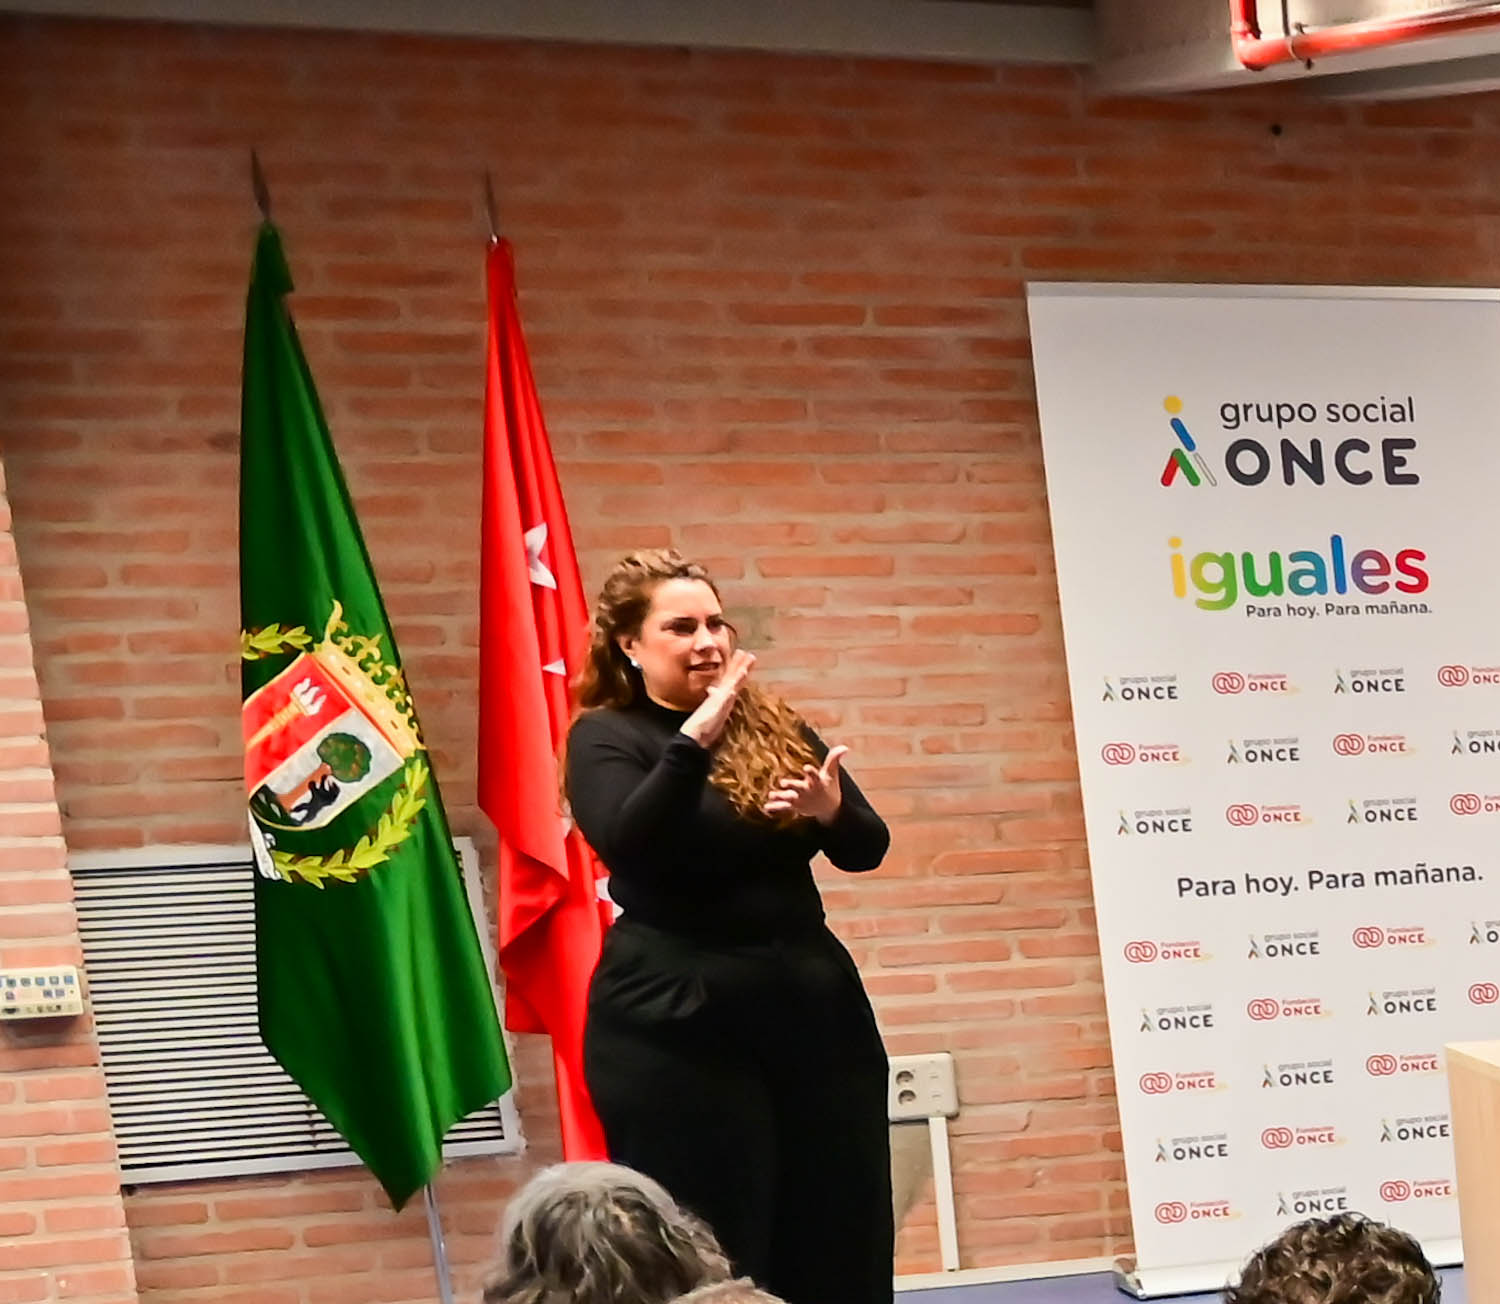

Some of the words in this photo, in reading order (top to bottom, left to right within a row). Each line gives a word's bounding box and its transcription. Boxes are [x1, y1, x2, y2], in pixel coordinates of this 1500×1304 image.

[1221, 403, 1316, 429] grupo
[1327, 396, 1414, 422] social
[1225, 438, 1419, 486] ONCE
[1168, 534, 1430, 611] iguales
[1246, 605, 1281, 617] Para
[1287, 603, 1319, 618] hoy.
[1325, 603, 1360, 615] Para
[1365, 601, 1432, 614] mañana.
[1122, 686, 1178, 700] ONCE
[1249, 681, 1287, 691] ONCE
[1352, 679, 1404, 693] ONCE
[1368, 742, 1405, 752] ONCE
[1140, 751, 1179, 762] ONCE
[1245, 748, 1299, 762] ONCE
[1263, 812, 1300, 823] ONCE
[1365, 808, 1417, 822] ONCE
[1136, 819, 1192, 834] ONCE
[1178, 878, 1235, 897] Para
[1245, 873, 1298, 896] hoy.
[1308, 871, 1365, 890] Para
[1375, 863, 1482, 886] mañana.
[1388, 934, 1424, 944] ONCE
[1161, 948, 1200, 959] ONCE
[1266, 942, 1319, 957] ONCE
[1283, 1005, 1320, 1016] ONCE
[1384, 998, 1436, 1013] ONCE
[1159, 1014, 1213, 1030] ONCE
[1400, 1060, 1437, 1072] ONCE
[1176, 1078, 1215, 1090] ONCE
[1280, 1070, 1333, 1086] ONCE
[1297, 1133, 1334, 1144] ONCE
[1398, 1124, 1449, 1140] ONCE
[1173, 1144, 1228, 1160] ONCE
[1414, 1186, 1450, 1197] ONCE
[1294, 1197, 1347, 1213] ONCE
[1191, 1207, 1229, 1219] ONCE
